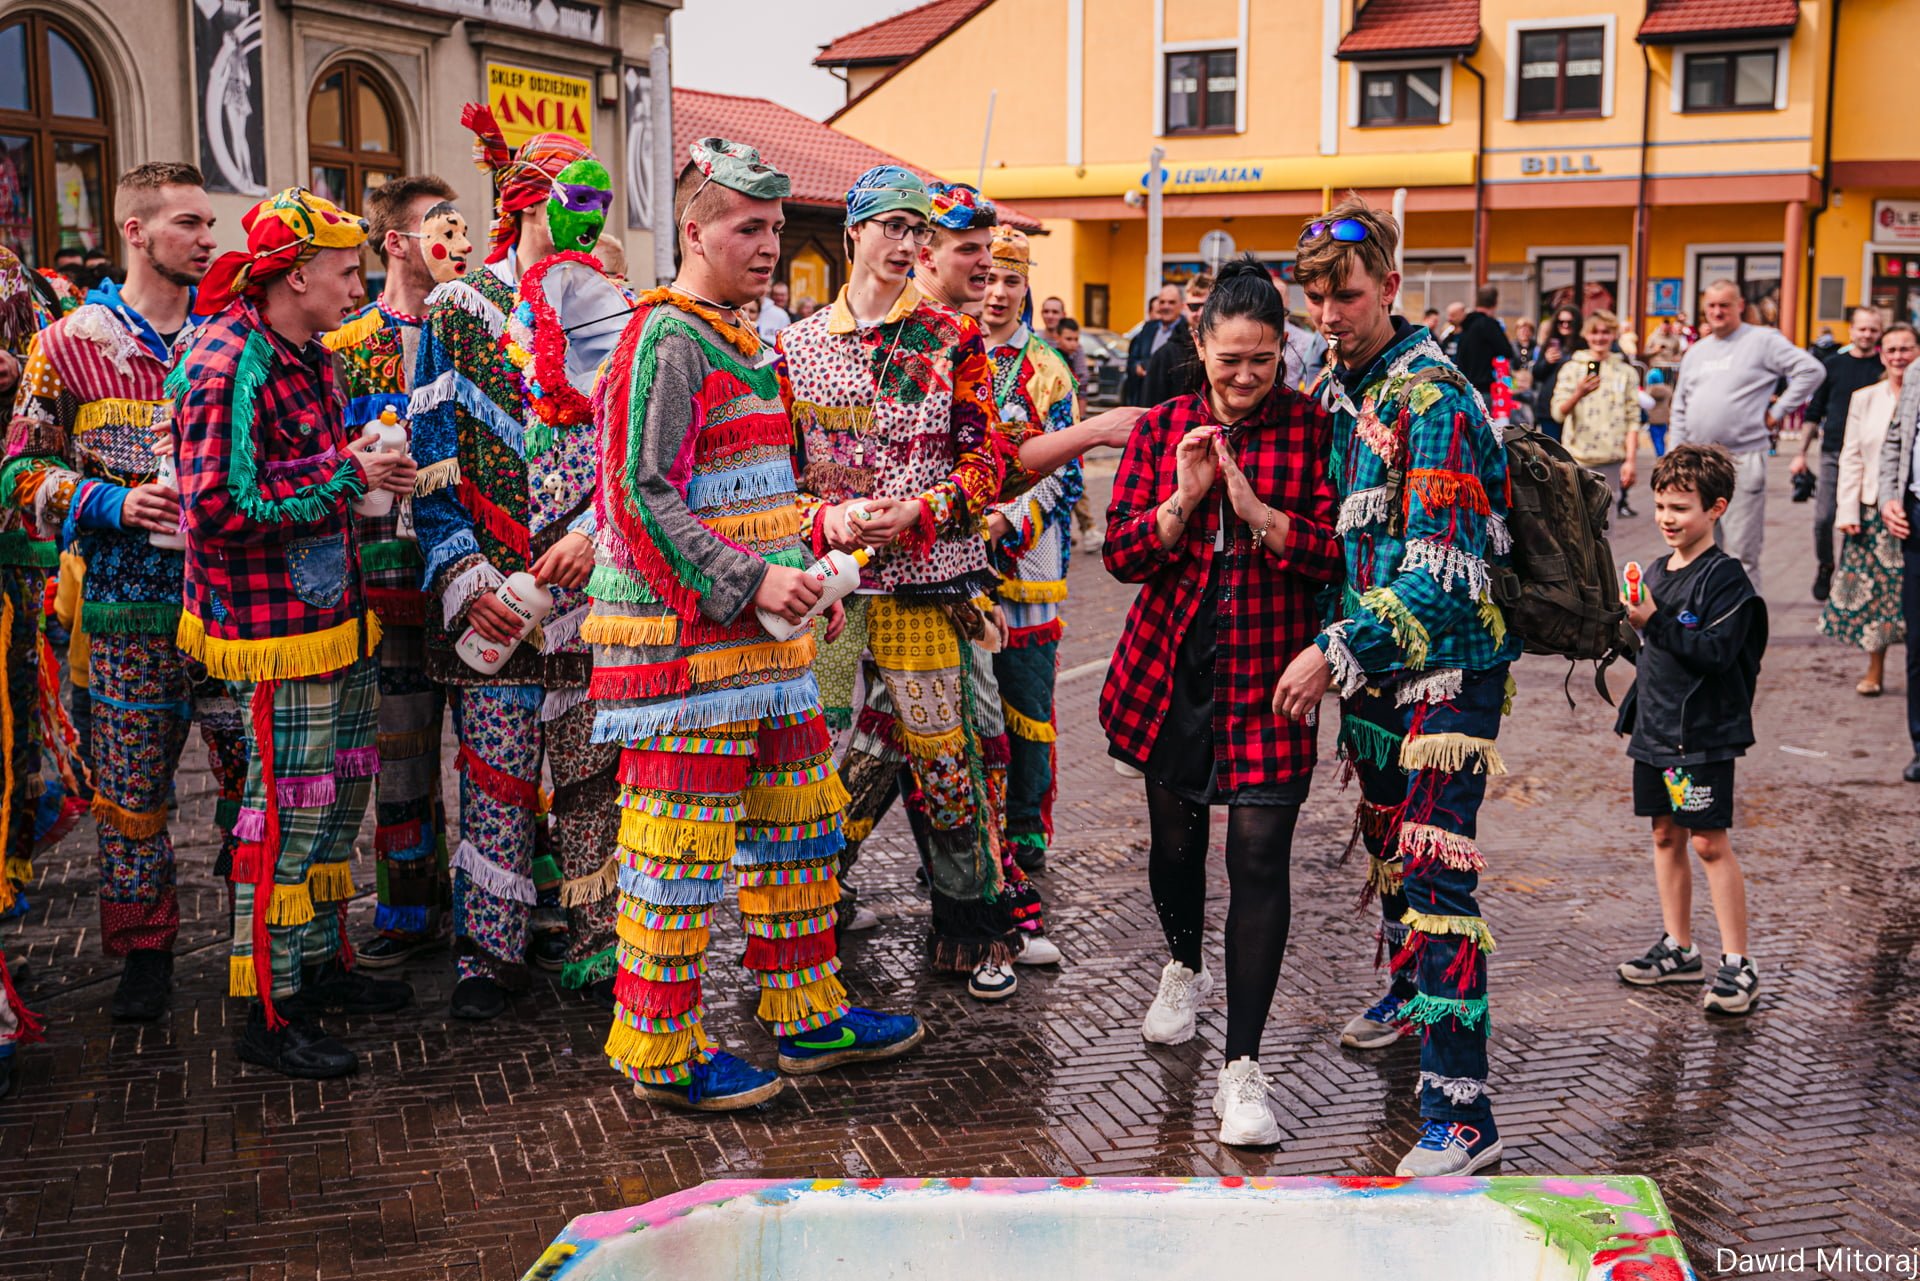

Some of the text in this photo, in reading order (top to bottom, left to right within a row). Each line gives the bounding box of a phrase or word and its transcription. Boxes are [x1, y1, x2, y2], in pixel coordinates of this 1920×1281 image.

[491, 69, 587, 99] SKLEP ODZIEŻOWY
[1175, 166, 1264, 184] LEWIATAN
[1521, 154, 1602, 174] BILL
[501, 593, 534, 621] ludwik
